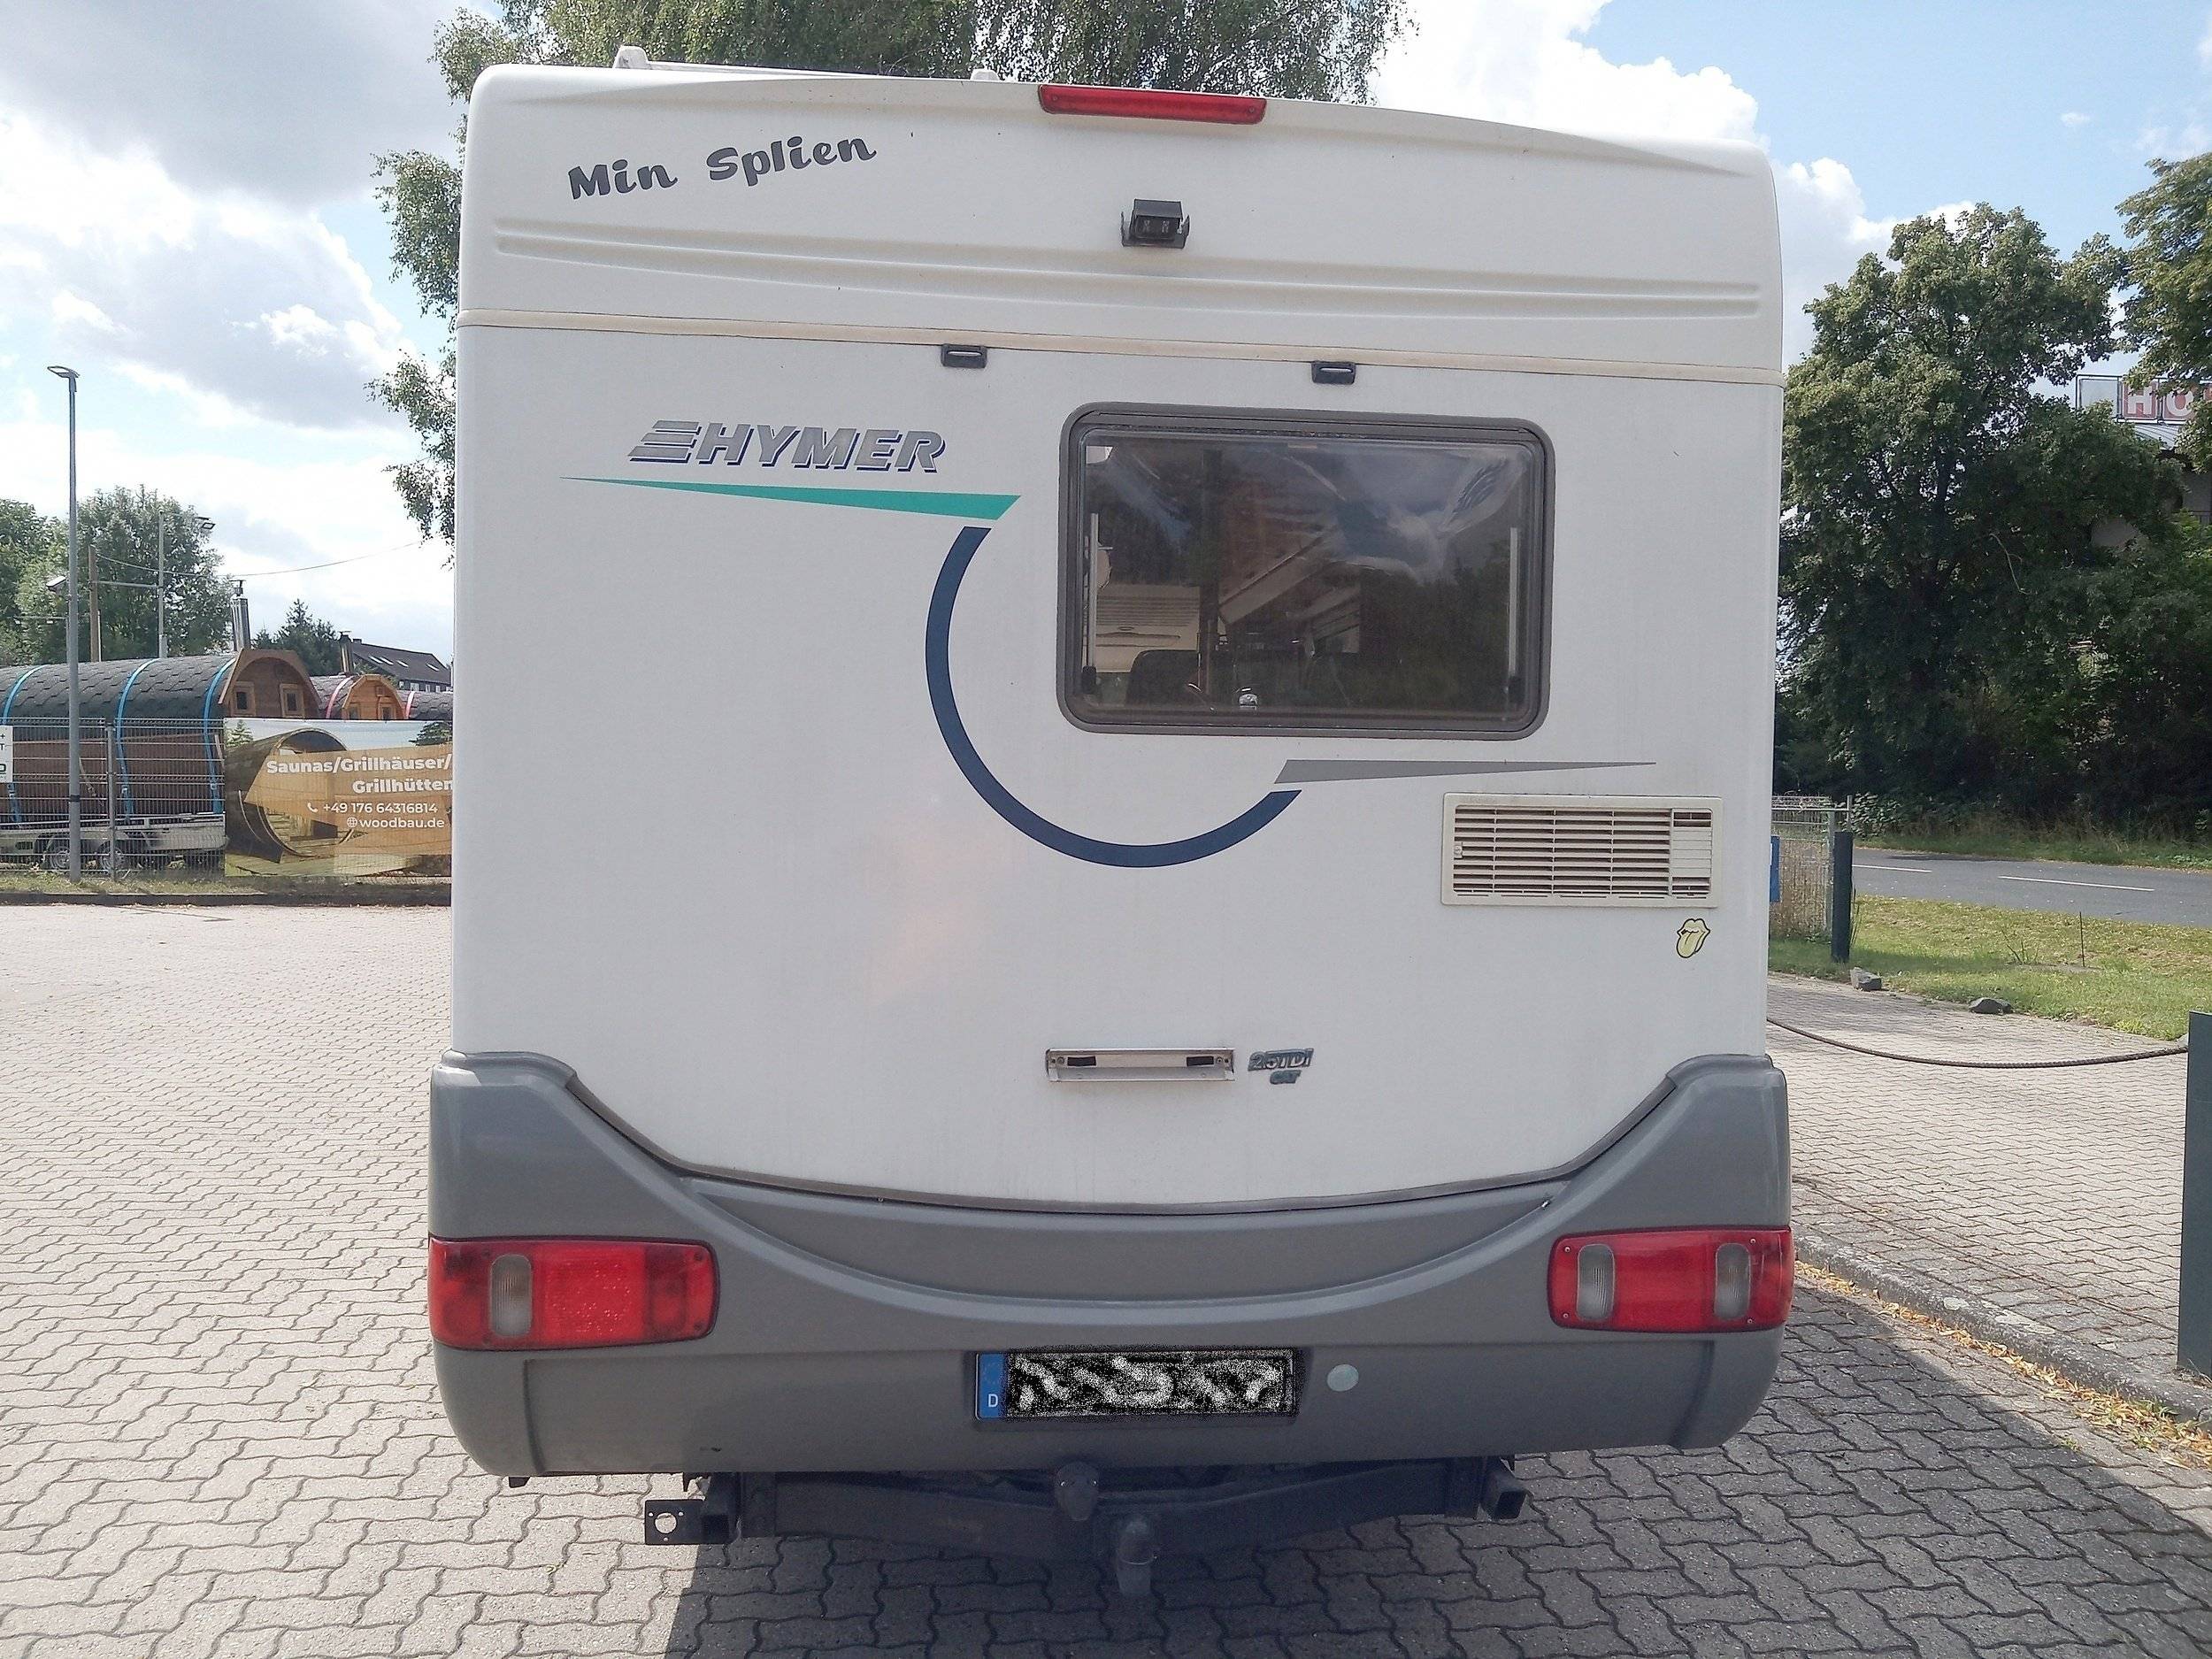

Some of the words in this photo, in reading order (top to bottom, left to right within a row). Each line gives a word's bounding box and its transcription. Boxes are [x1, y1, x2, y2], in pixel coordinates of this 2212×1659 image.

[567, 158, 679, 200] Min
[706, 135, 877, 187] Splien
[695, 421, 946, 473] HYMER
[323, 803, 348, 814] +49
[350, 803, 373, 813] 176
[376, 803, 439, 813] 64316814
[359, 817, 445, 829] woodbau.de
[987, 1393, 999, 1408] D
